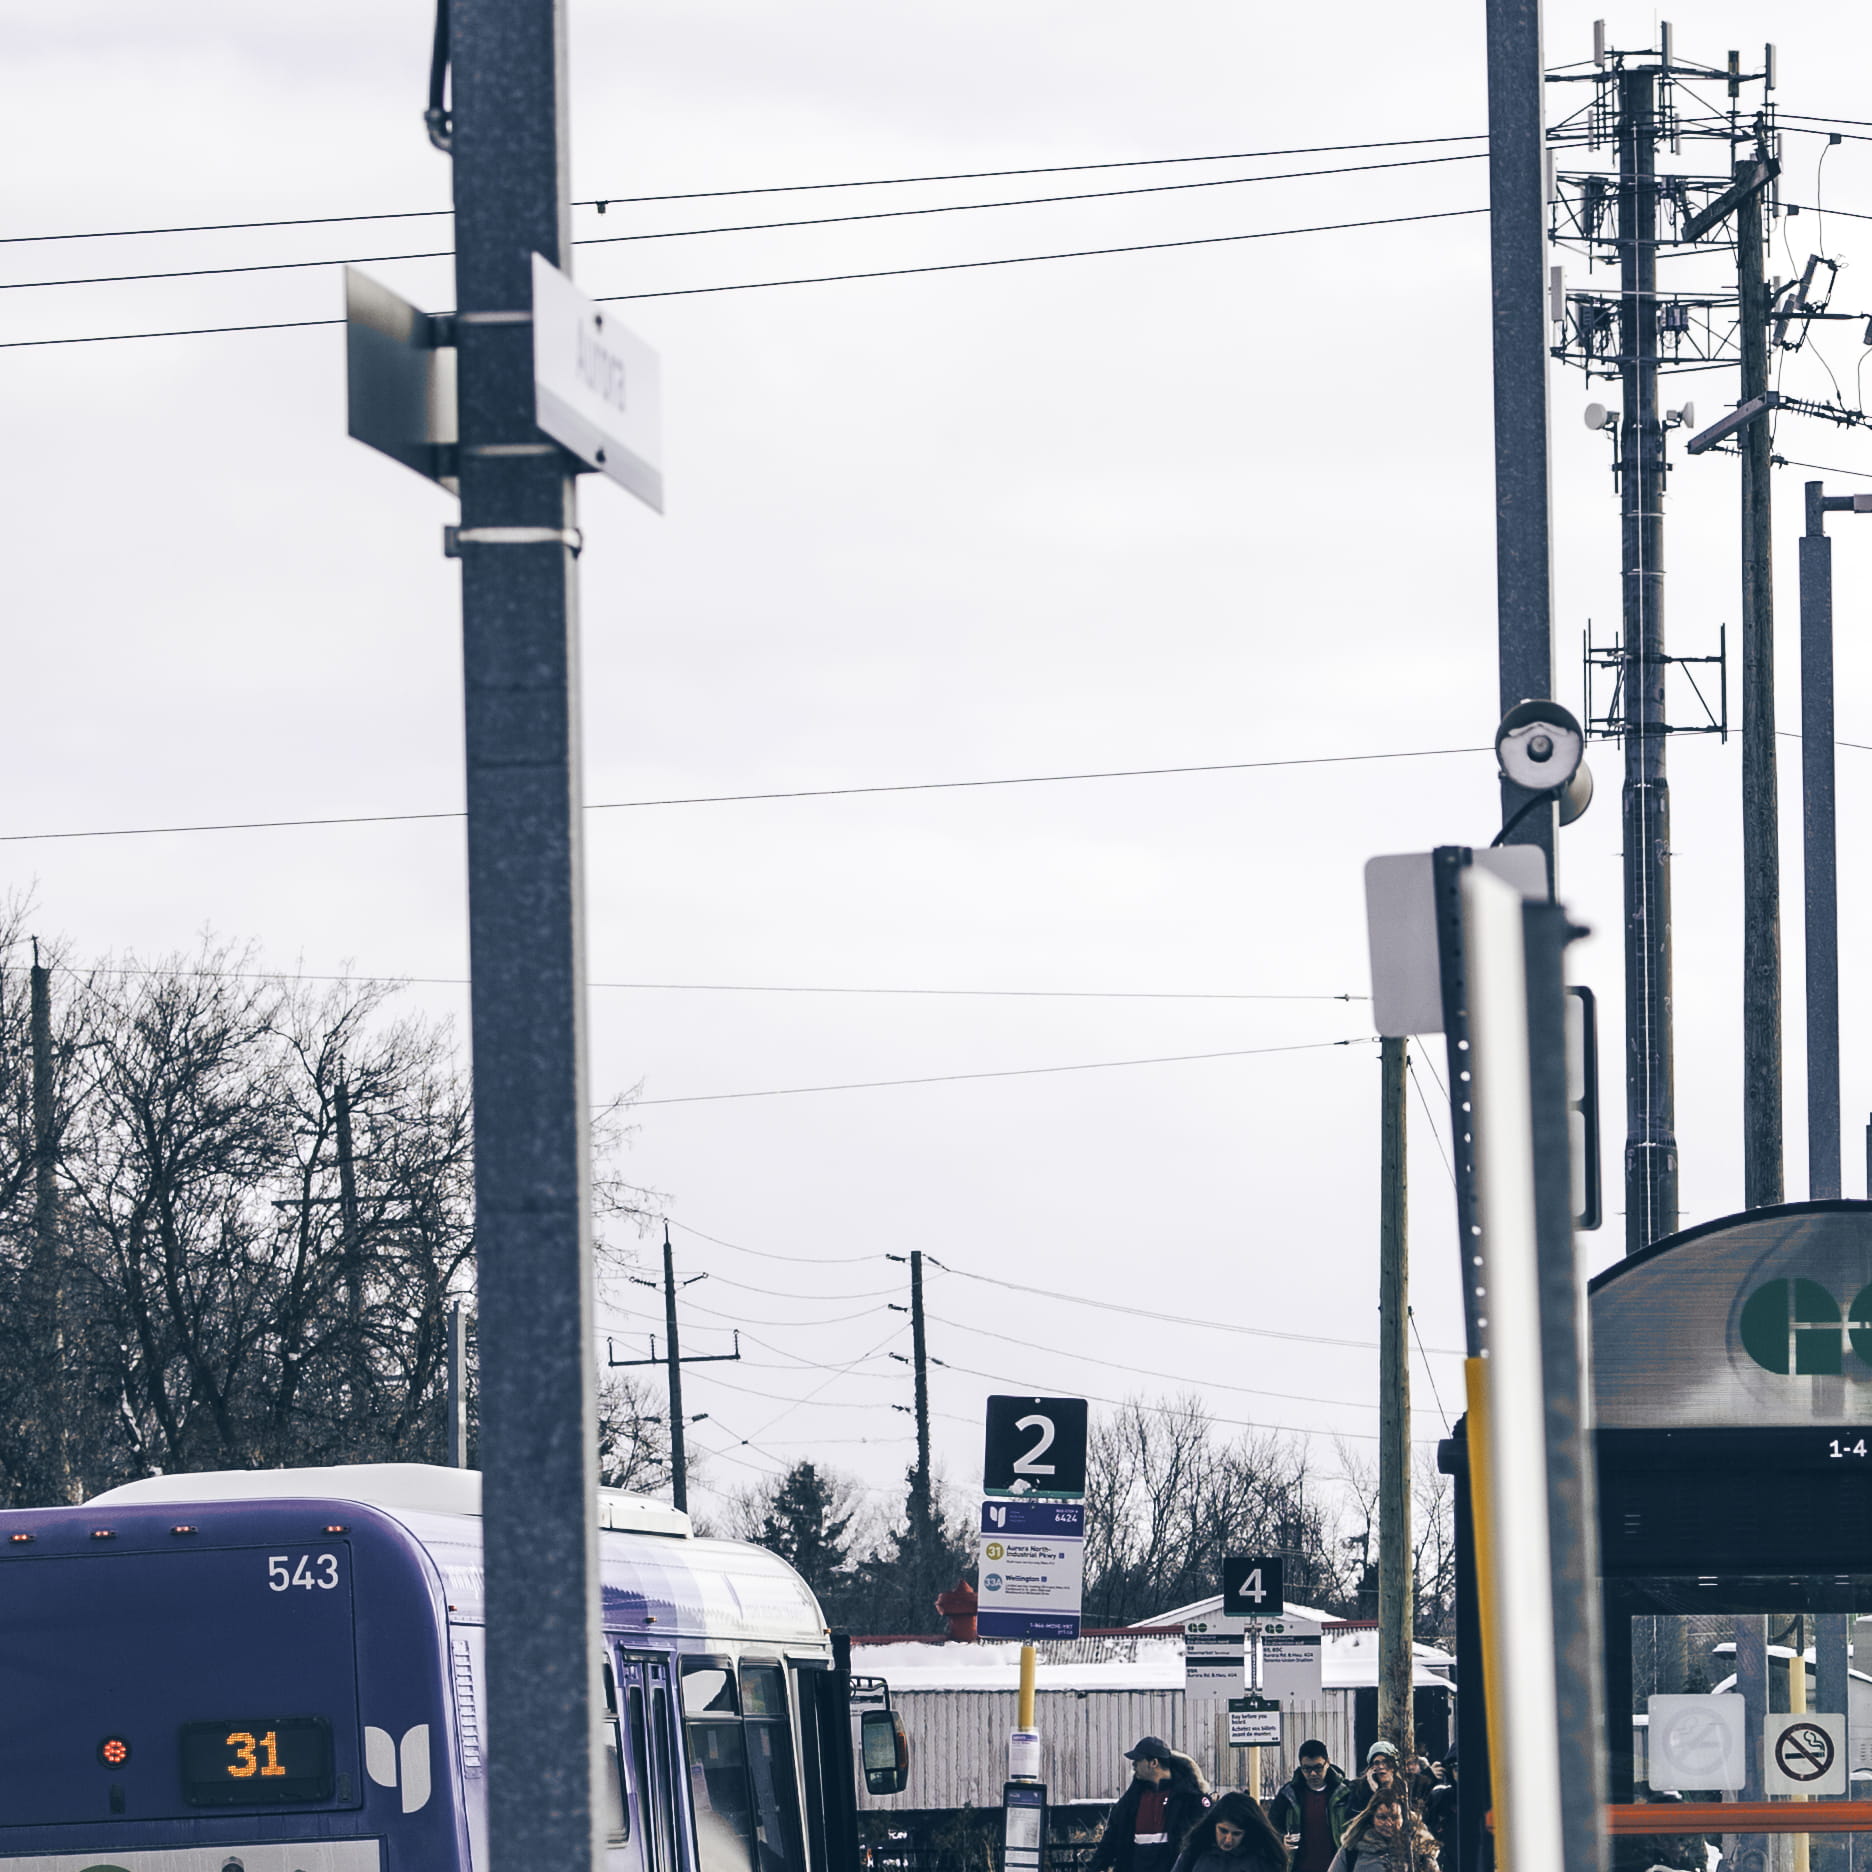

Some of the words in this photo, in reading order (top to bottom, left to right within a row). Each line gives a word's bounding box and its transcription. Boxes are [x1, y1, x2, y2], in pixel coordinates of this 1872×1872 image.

[1012, 1414, 1056, 1475] 2
[1829, 1438, 1867, 1458] 1-4
[1055, 1514, 1077, 1522] 6424
[988, 1546, 1001, 1558] 31
[268, 1553, 339, 1592] 543
[1237, 1568, 1267, 1604] 4
[226, 1731, 286, 1777] 31
